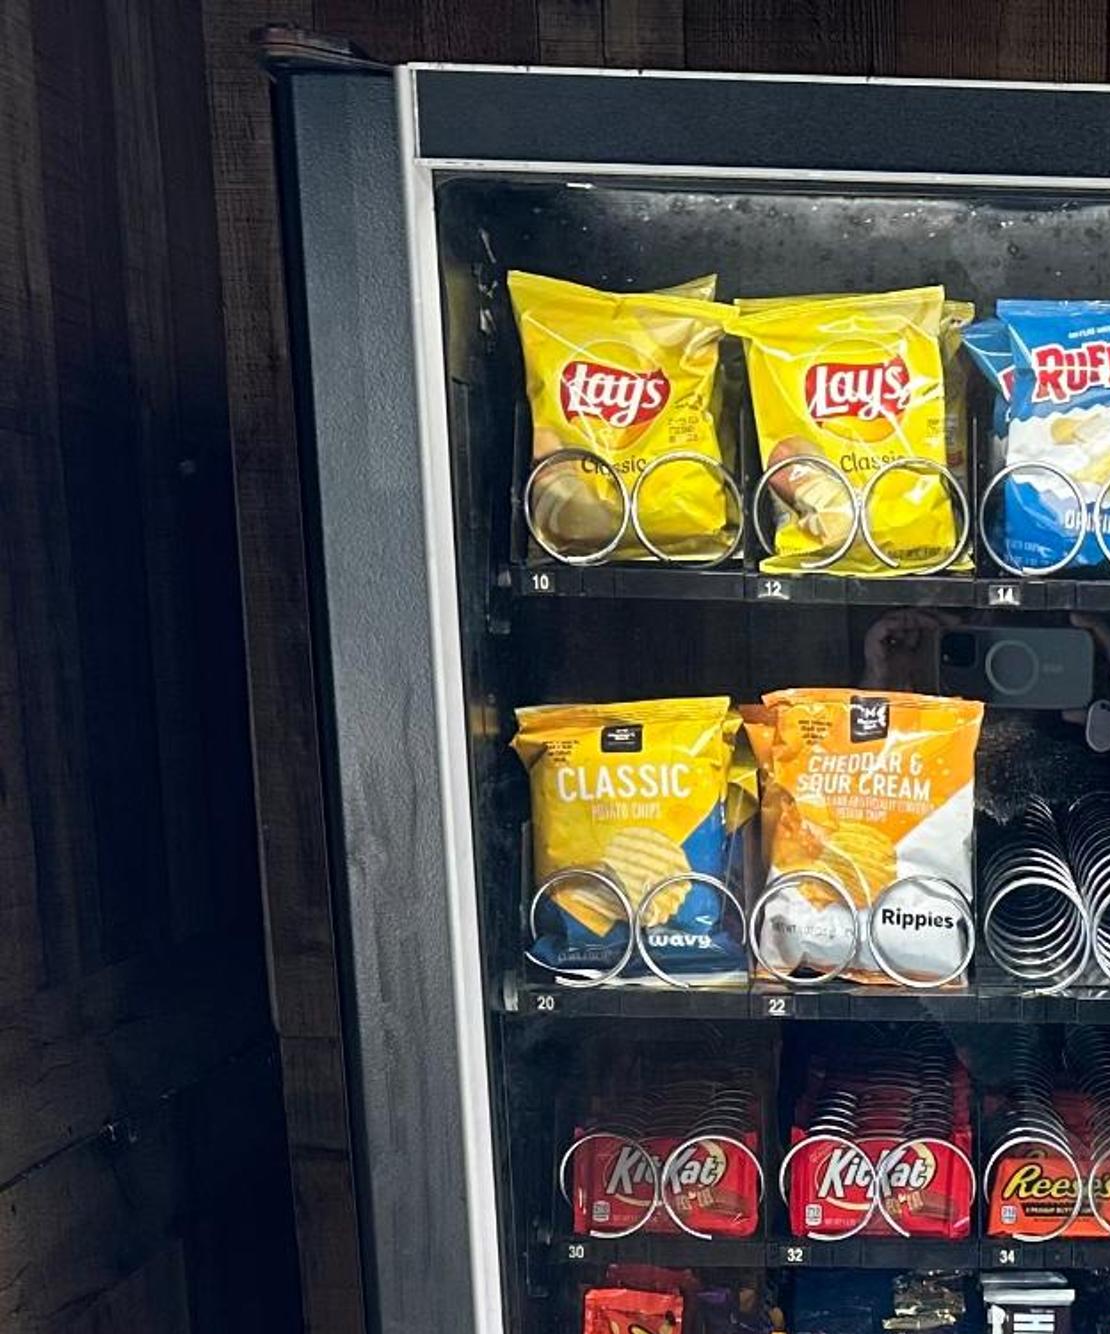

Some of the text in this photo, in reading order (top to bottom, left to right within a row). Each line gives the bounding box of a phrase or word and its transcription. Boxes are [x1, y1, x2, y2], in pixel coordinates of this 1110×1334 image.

[563, 361, 669, 428] Lay's
[810, 358, 911, 424] Lay's
[581, 455, 647, 477] Classic
[532, 574, 549, 590] 10
[765, 581, 783, 597] 12
[997, 587, 1014, 602] 14
[808, 751, 923, 776] CHEDDAR &
[557, 762, 692, 802] CLASSIC
[796, 773, 931, 801] SOUR CREAM
[881, 908, 954, 931] Rippies
[648, 933, 713, 949] wavy
[538, 996, 555, 1010] 20
[768, 999, 786, 1014] 22
[568, 1245, 585, 1260] 30
[787, 1248, 804, 1263] 32
[999, 1250, 1016, 1264] 34
